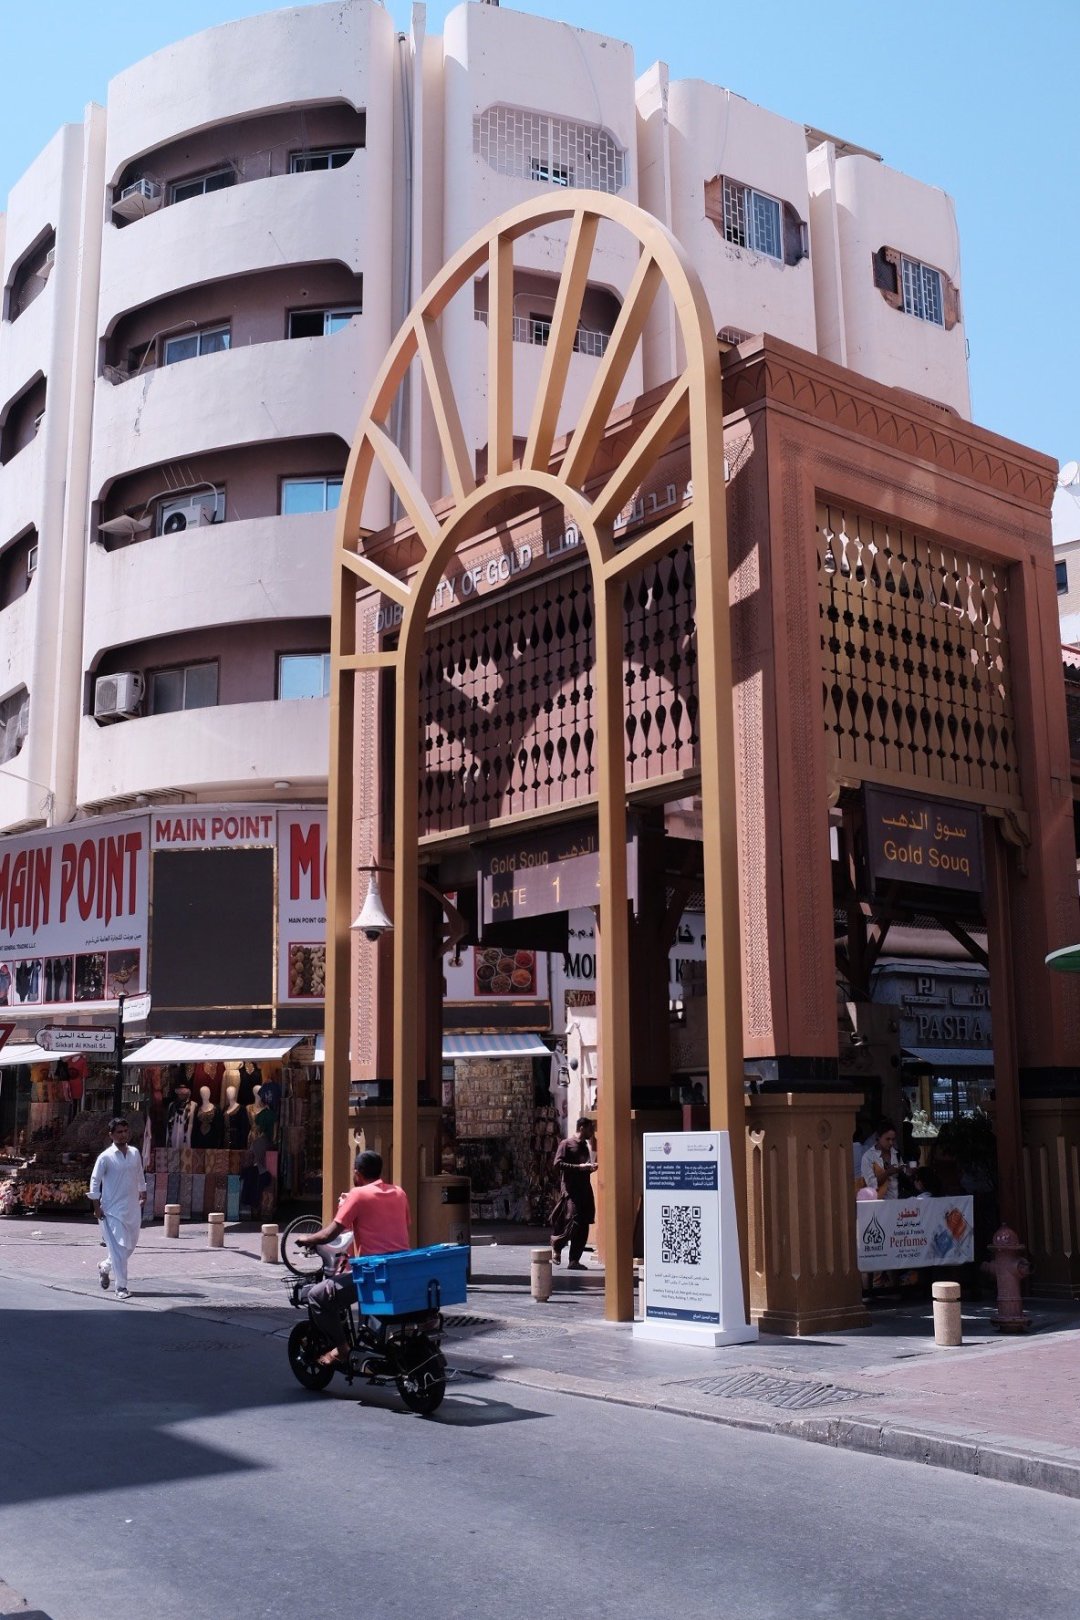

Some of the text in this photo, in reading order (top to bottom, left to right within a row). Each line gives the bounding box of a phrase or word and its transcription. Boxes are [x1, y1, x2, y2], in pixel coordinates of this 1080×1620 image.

[461, 565, 484, 596] OF
[488, 543, 533, 586] GOLD
[156, 815, 273, 842] MAIN POINT
[882, 810, 967, 841] سوق الذهب
[490, 853, 516, 876] Gold
[884, 840, 970, 878] Gold Souq
[59, 831, 142, 928] POINT
[490, 875, 561, 910] GATE 1
[55, 1032, 75, 1040] الخيل
[95, 1032, 112, 1041] شارع
[919, 1014, 985, 1041] PASHA
[890, 1235, 928, 1249] Perfumes
